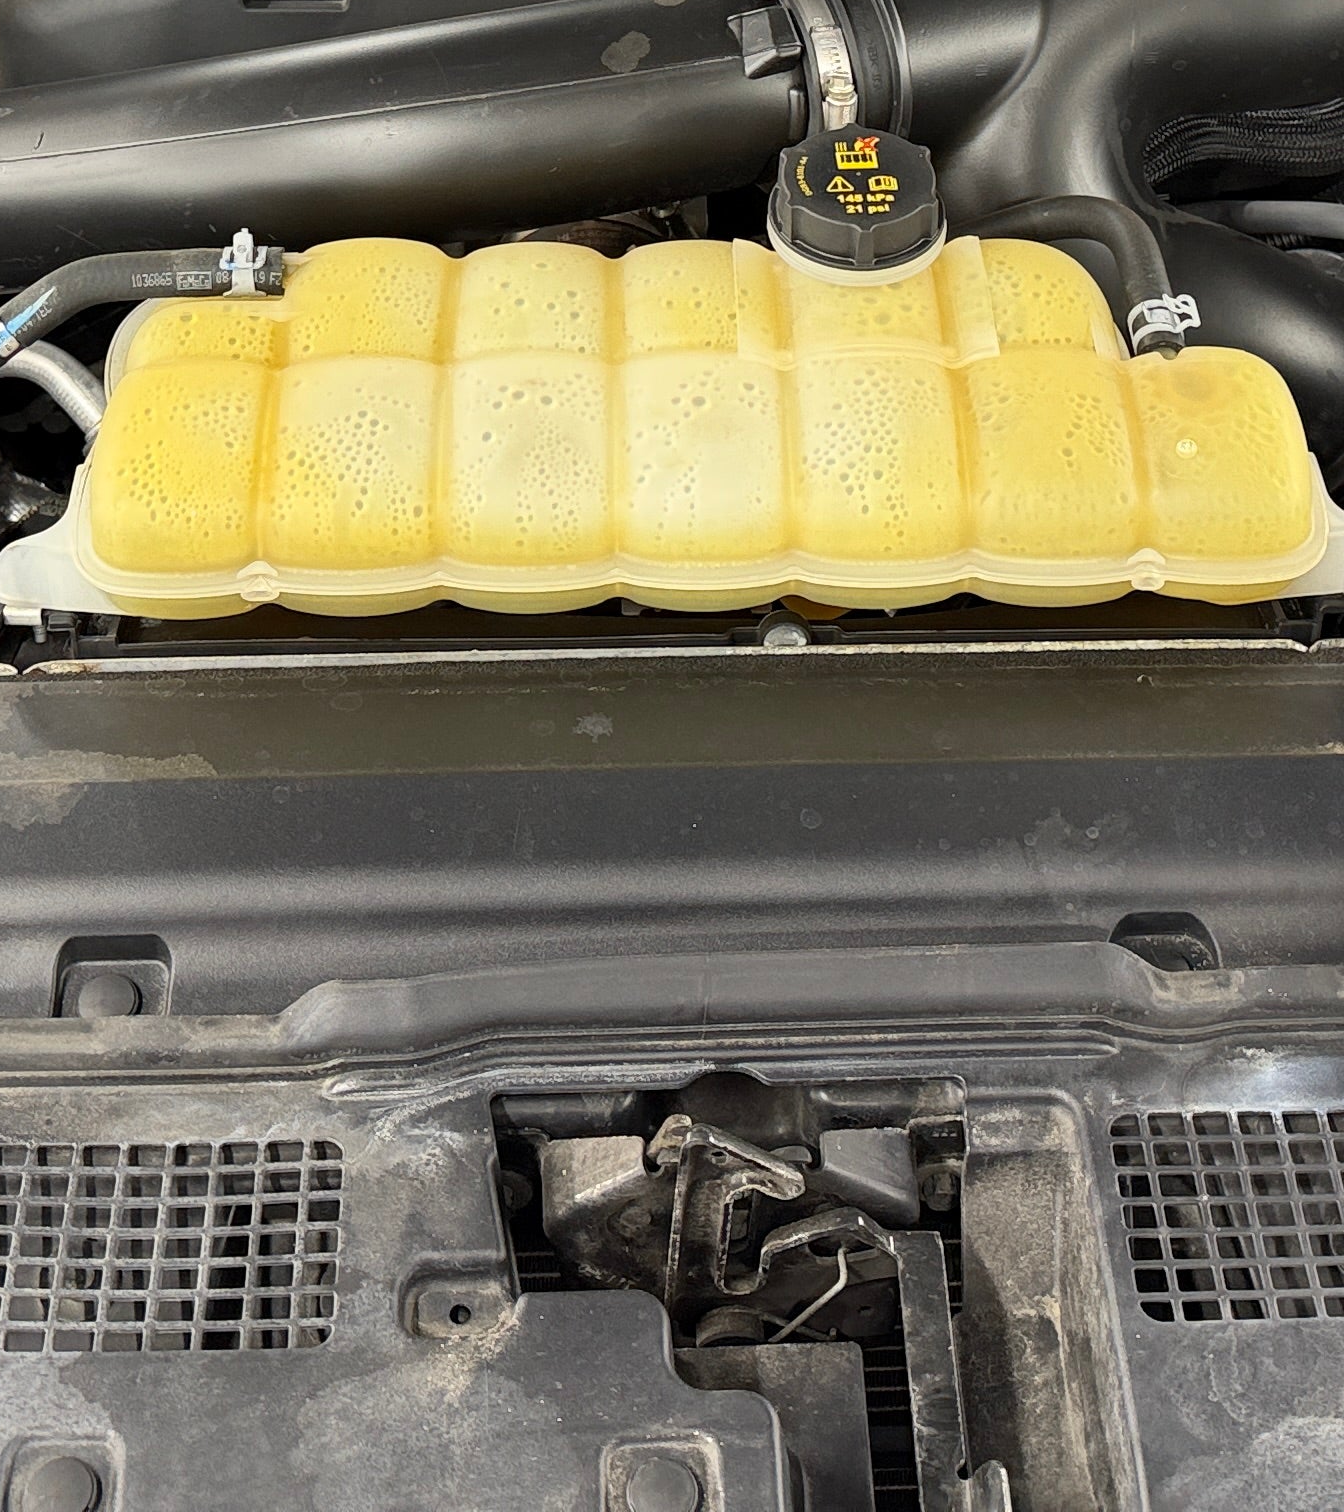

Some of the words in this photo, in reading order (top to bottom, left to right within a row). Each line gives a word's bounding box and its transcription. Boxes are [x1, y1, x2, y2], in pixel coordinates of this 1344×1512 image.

[837, 194, 863, 204] 145
[866, 193, 895, 202] kPa
[846, 204, 863, 214] 21
[867, 203, 890, 215] psi
